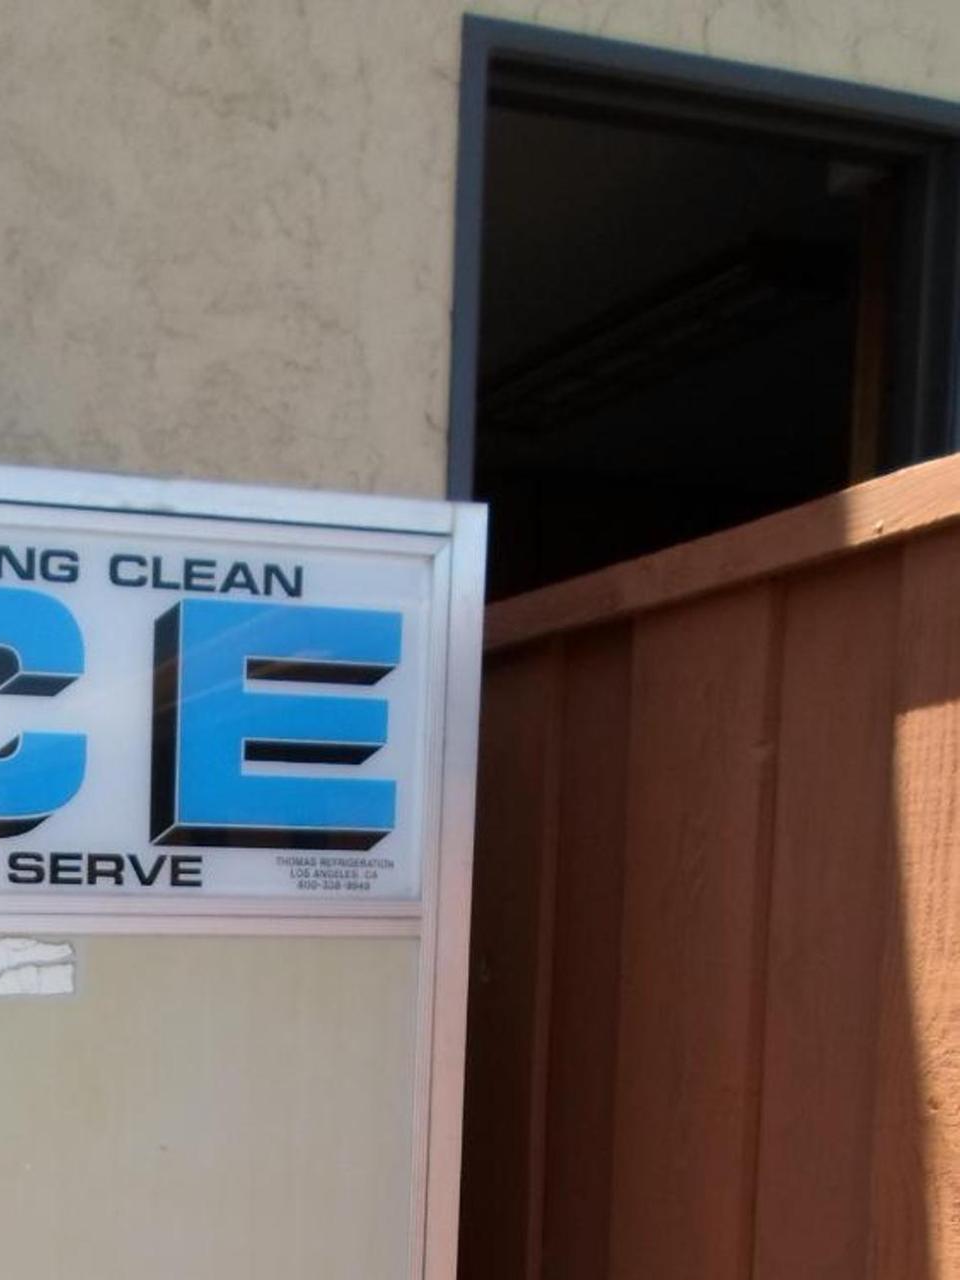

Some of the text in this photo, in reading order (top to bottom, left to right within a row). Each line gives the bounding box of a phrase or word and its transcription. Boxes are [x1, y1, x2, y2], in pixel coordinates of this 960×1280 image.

[108, 553, 304, 599] CLEAN
[8, 851, 203, 888] SERVE
[276, 856, 317, 867] THOMAS
[290, 868, 311, 879] LOS
